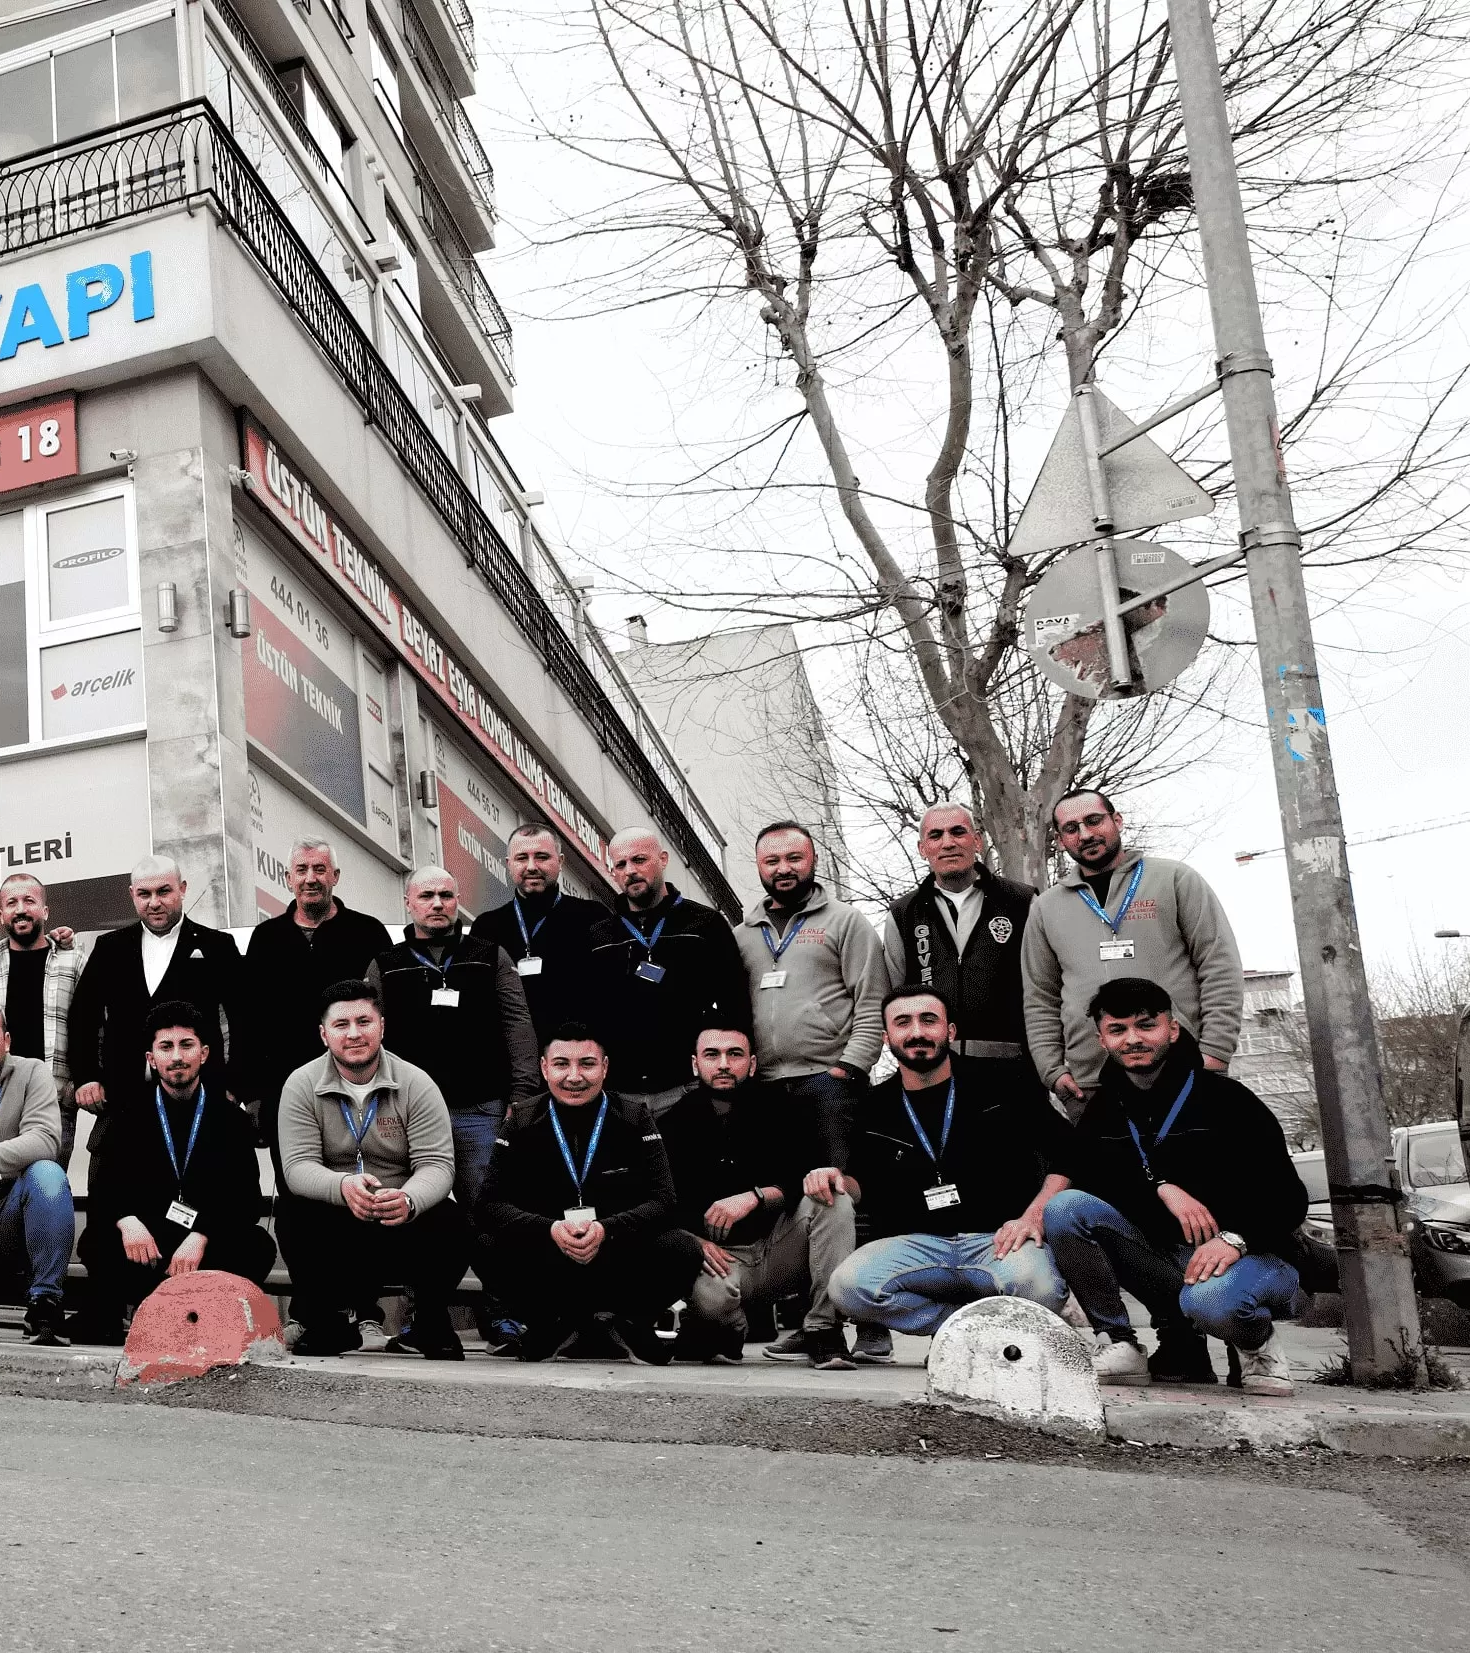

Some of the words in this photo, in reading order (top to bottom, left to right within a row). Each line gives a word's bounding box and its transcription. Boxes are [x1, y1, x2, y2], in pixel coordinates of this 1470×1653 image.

[18, 418, 62, 462] 18
[58, 549, 122, 568] PROFİLO
[266, 440, 328, 553] ÜSTÜN
[330, 522, 392, 625] TEKNİK
[401, 604, 445, 683] BEYAZ
[447, 656, 477, 719] EŞYA
[478, 691, 514, 762] KOMBİ
[270, 575, 293, 615] 444
[297, 600, 311, 633] 01
[315, 618, 330, 650] 36
[71, 669, 135, 697] arçelik
[257, 628, 299, 694] ÜSTÜN
[300, 672, 344, 735] TEKNİK
[1129, 899, 1157, 908] ERKEZ
[914, 924, 933, 987] GÜVE
[376, 1116, 403, 1127] MERKE
